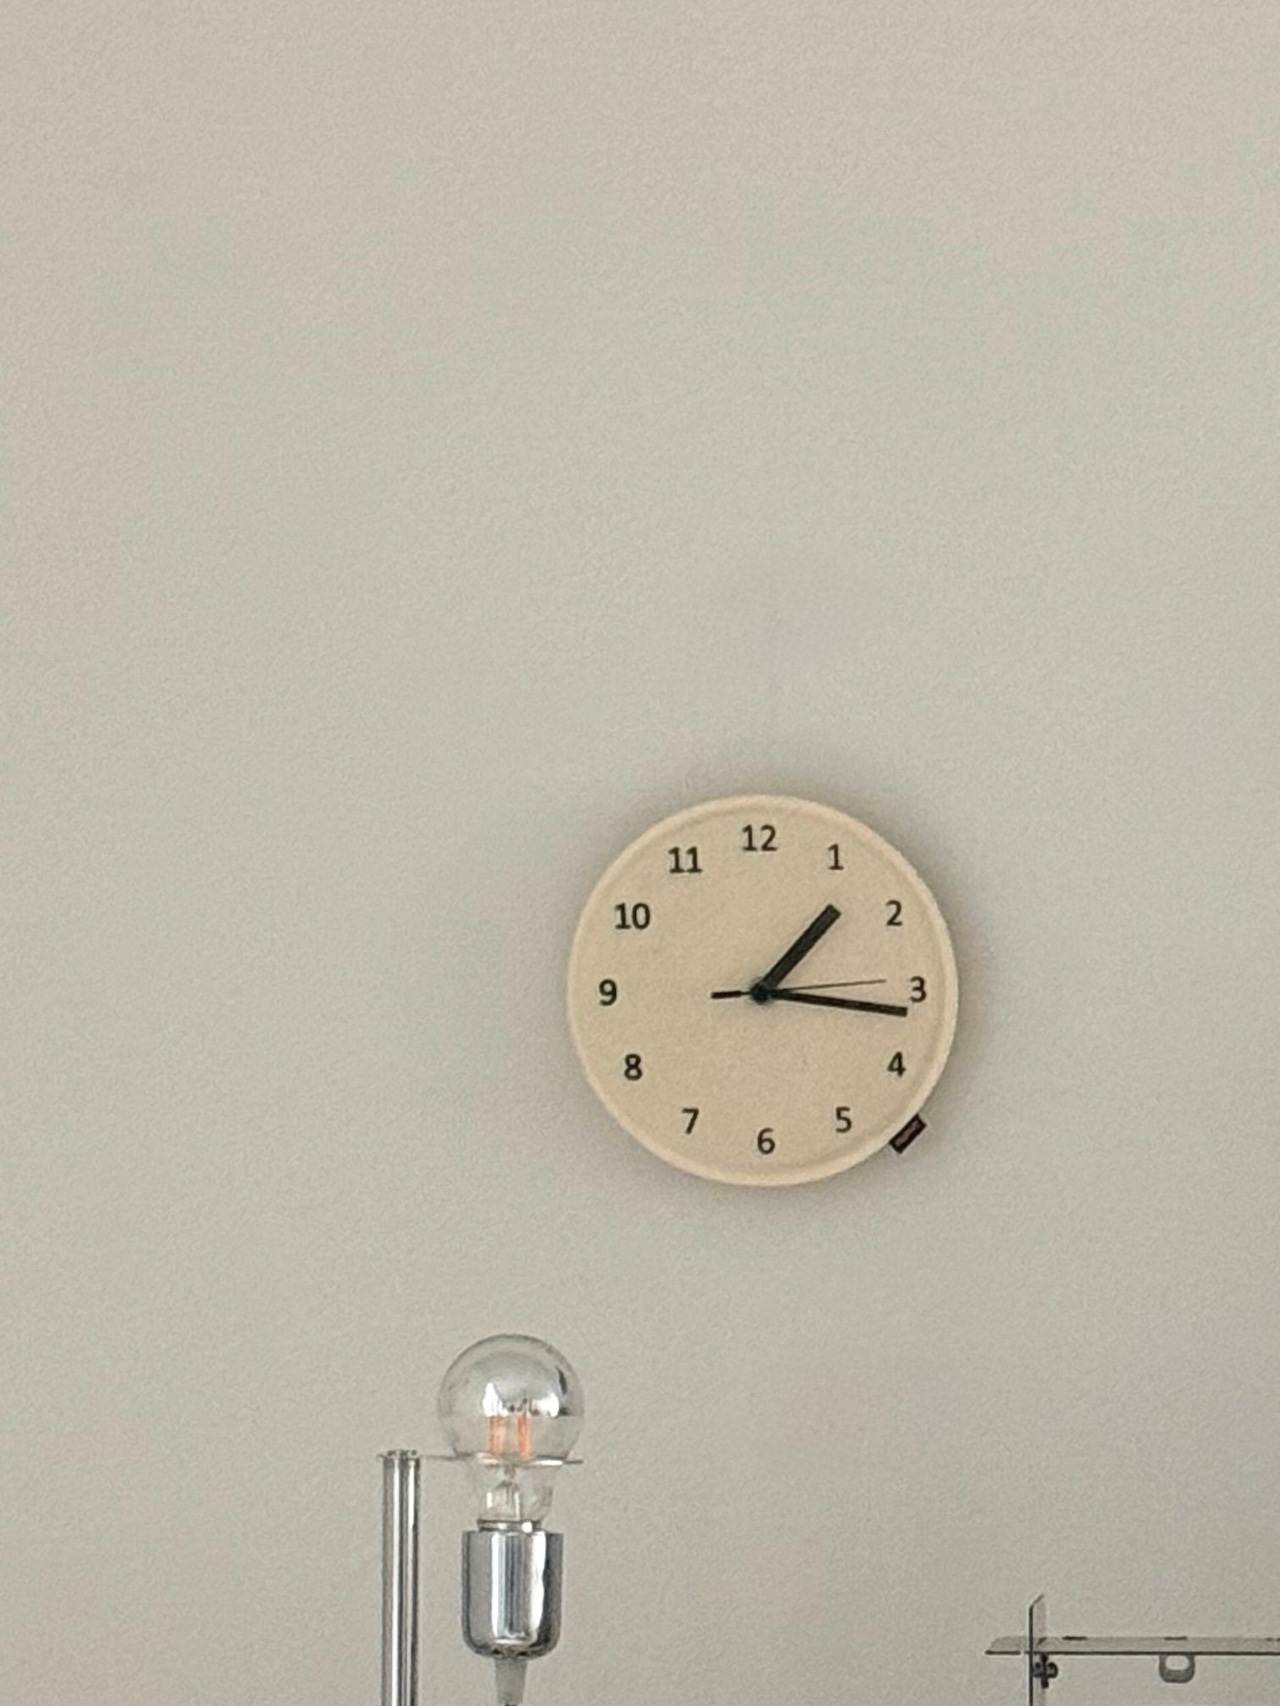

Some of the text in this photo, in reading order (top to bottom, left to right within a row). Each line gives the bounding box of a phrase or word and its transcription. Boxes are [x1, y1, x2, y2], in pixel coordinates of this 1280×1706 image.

[743, 825, 778, 851] 12
[668, 847, 702, 874] 11
[827, 844, 844, 870] 1
[614, 903, 651, 930] 10
[886, 900, 903, 927] 2
[599, 979, 618, 1006] 9
[910, 976, 927, 1003] 3
[624, 1053, 643, 1081] 8
[887, 1051, 906, 1078] 4
[682, 1108, 699, 1134] 7
[836, 1107, 852, 1133] 5
[757, 1128, 775, 1154] 6
